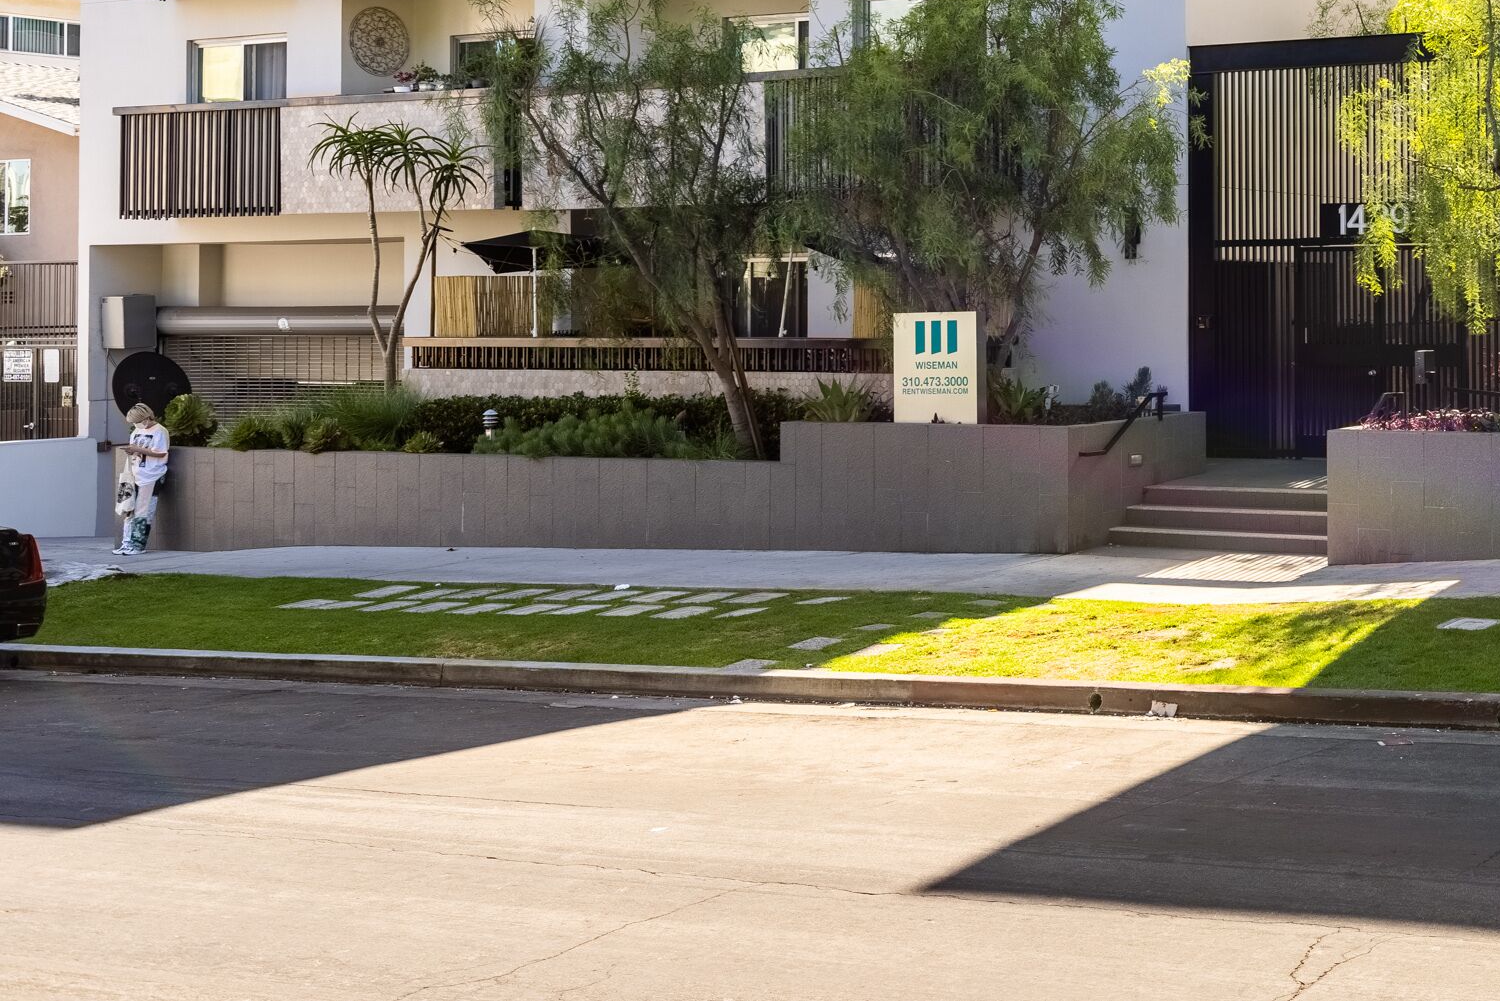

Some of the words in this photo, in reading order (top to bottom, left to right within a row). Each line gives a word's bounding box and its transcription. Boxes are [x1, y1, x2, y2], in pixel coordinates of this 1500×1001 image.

[1338, 203, 1408, 235] 149
[915, 361, 958, 370] WISEMAN
[902, 376, 969, 388] 310.473.3000
[902, 387, 969, 396] RENTWISEMAN.COM
